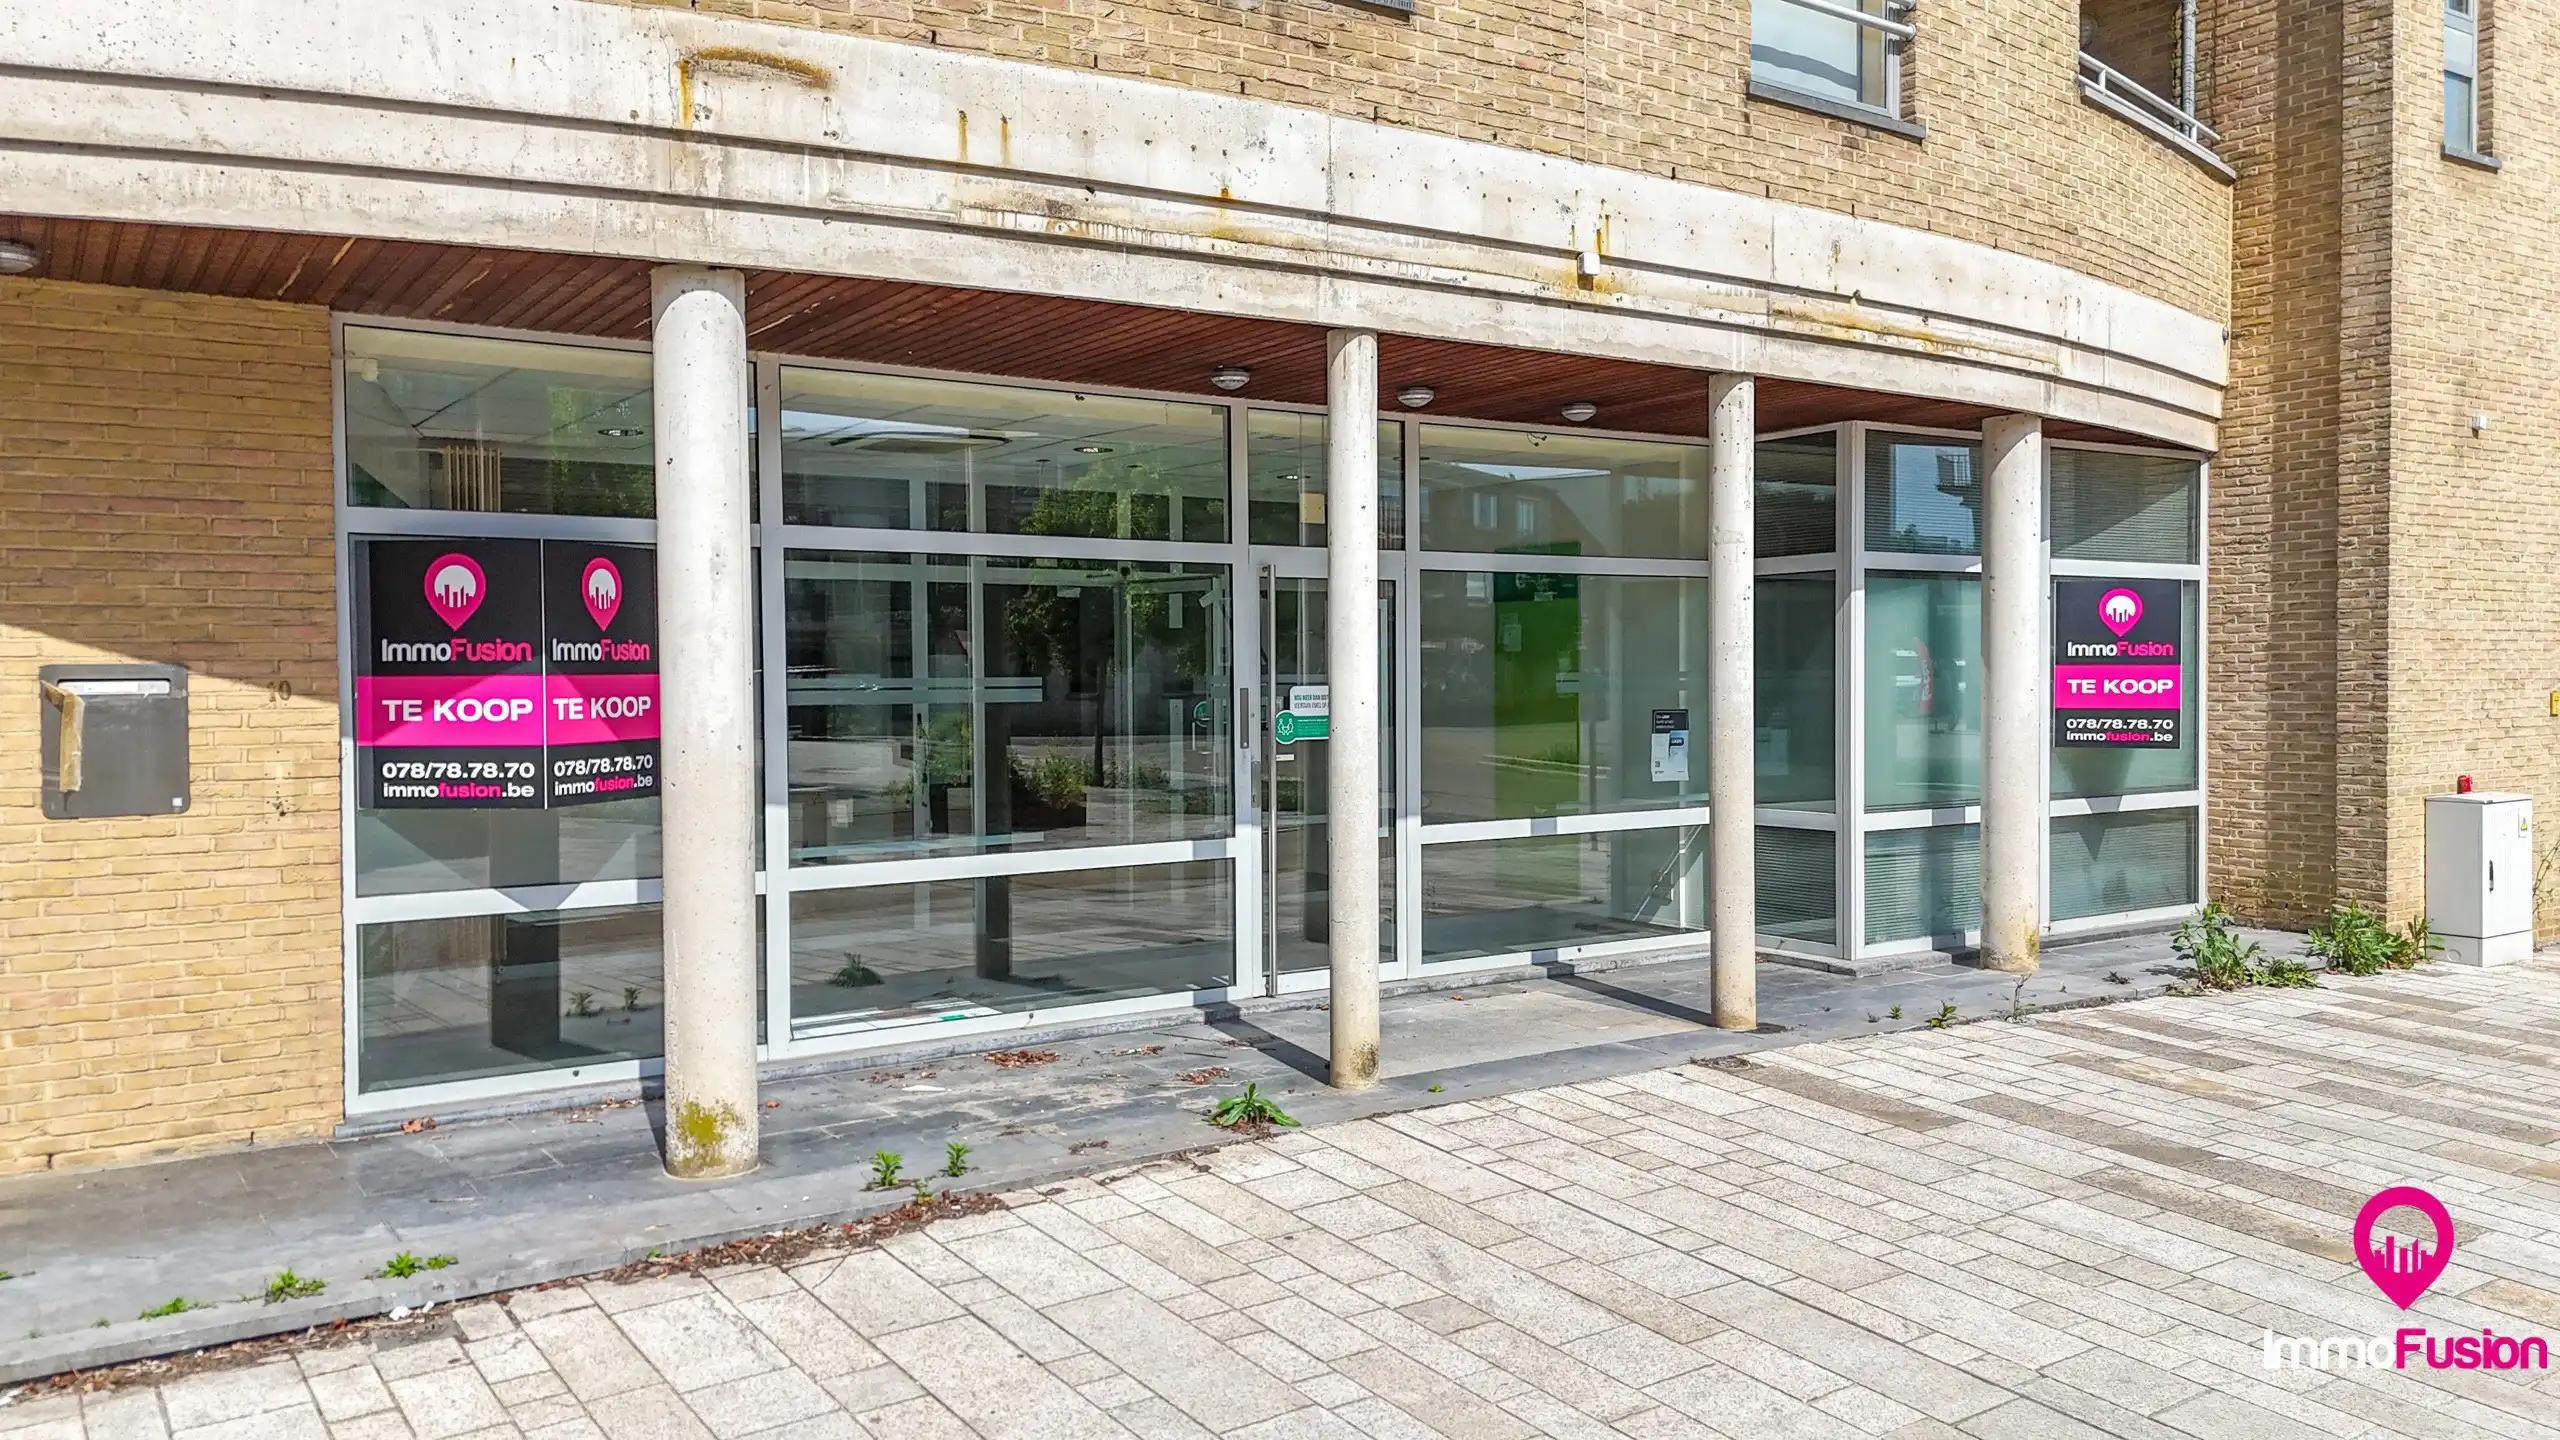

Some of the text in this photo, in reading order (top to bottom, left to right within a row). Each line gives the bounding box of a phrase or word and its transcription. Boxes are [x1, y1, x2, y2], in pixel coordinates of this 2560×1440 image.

[381, 637, 533, 663] ImmoFusion
[551, 637, 650, 662] ImmoFusion
[2067, 641, 2175, 657] ImmoFusion
[2066, 679, 2174, 695] TE KOOP
[381, 698, 534, 722] TE KOOP
[552, 696, 652, 721] TE KOOP
[2066, 718, 2174, 730] 078/78.78.70
[2066, 730, 2173, 742] immofusion.be
[381, 761, 536, 780] 078/78.78.70
[553, 754, 654, 777] 078/78.78.70
[382, 781, 535, 800] immofusion.be
[553, 773, 654, 798] immofusion.be
